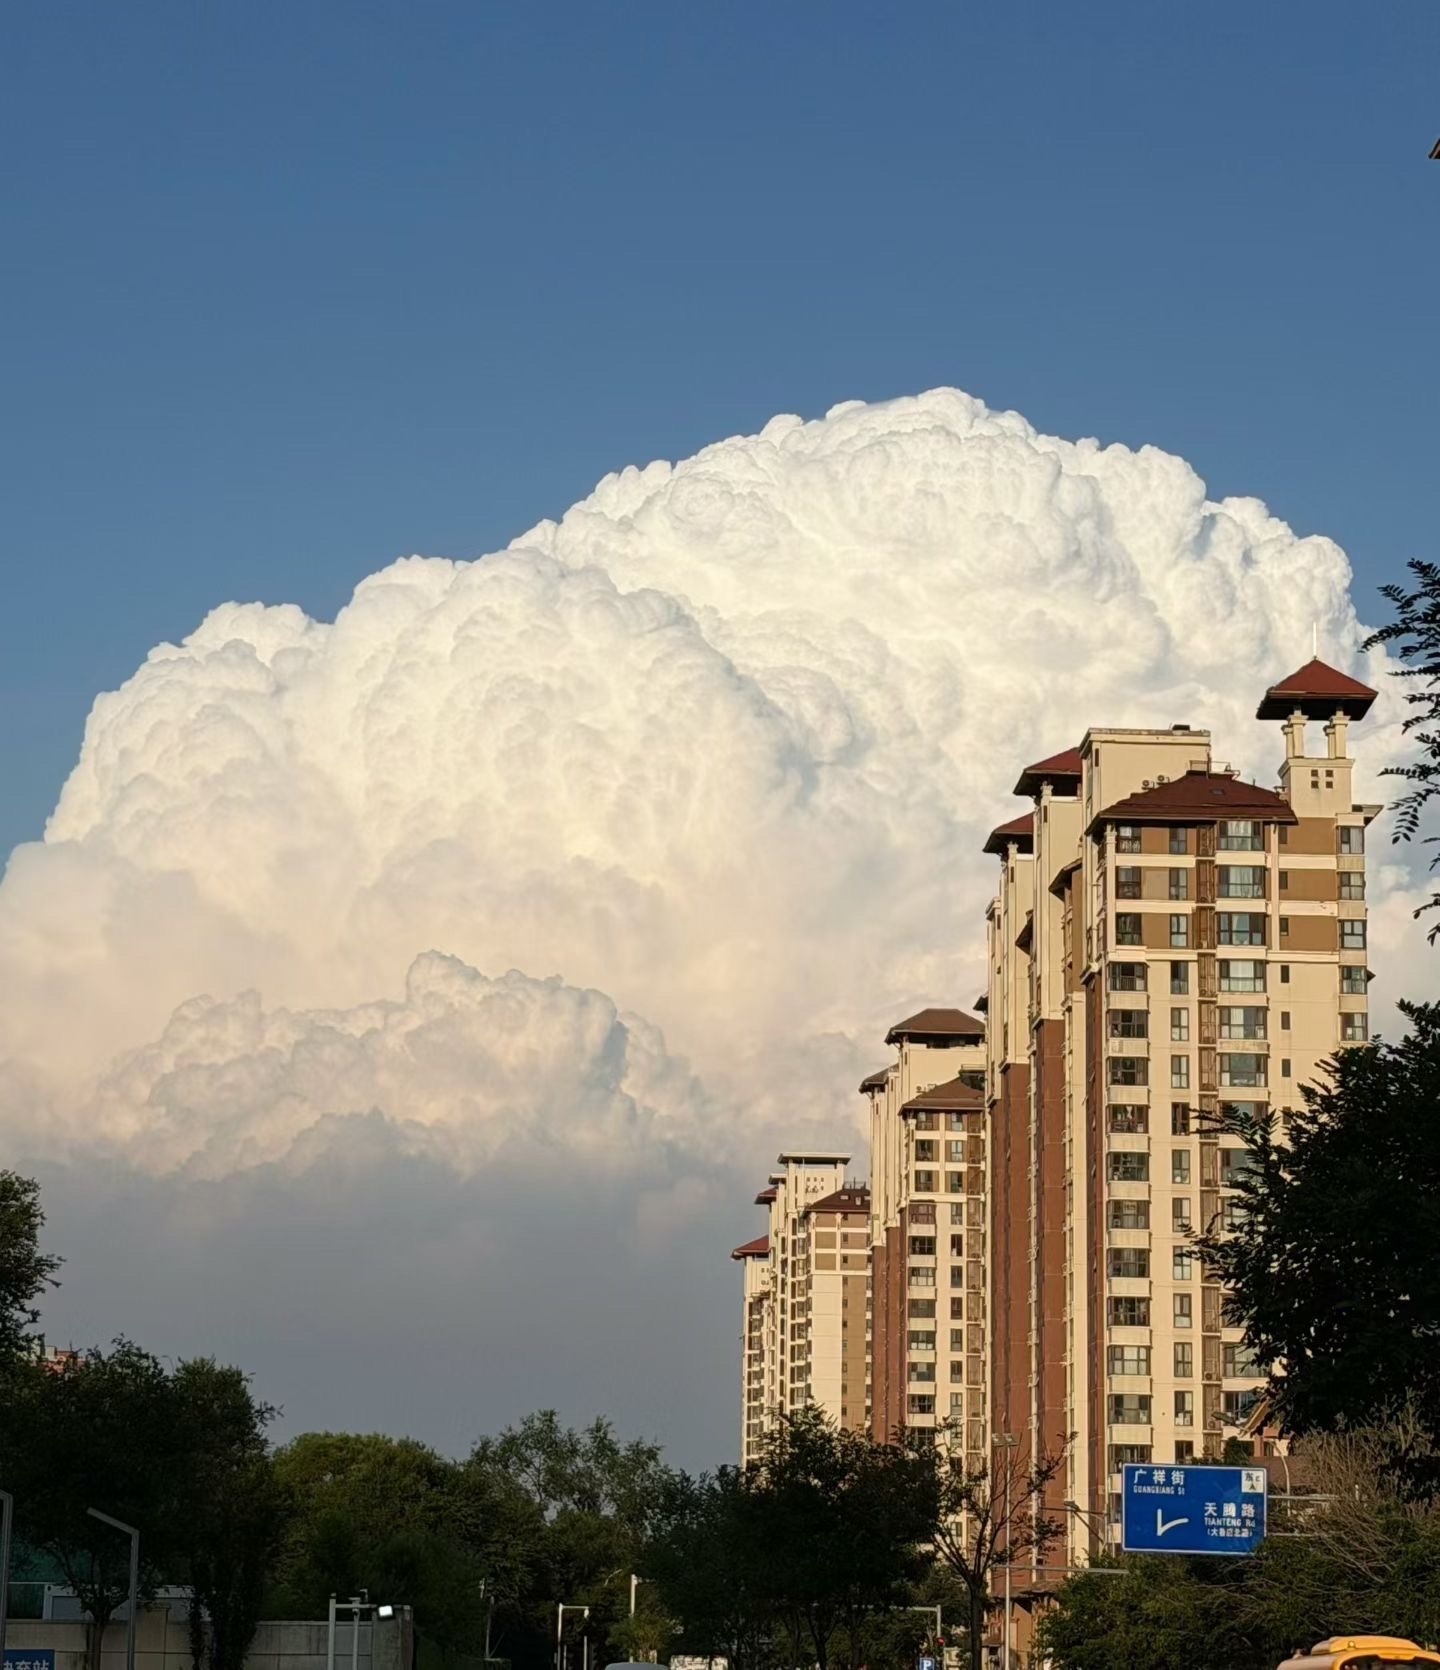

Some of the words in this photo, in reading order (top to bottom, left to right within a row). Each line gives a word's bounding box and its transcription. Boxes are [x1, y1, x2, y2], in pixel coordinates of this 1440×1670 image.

[1134, 1468, 1185, 1486] 广祥街
[1133, 1485, 1175, 1495] GUANGXIANG
[1204, 1517, 1242, 1527] TIANTENG
[1245, 1518, 1256, 1528] Rd
[923, 1659, 932, 1670] P
